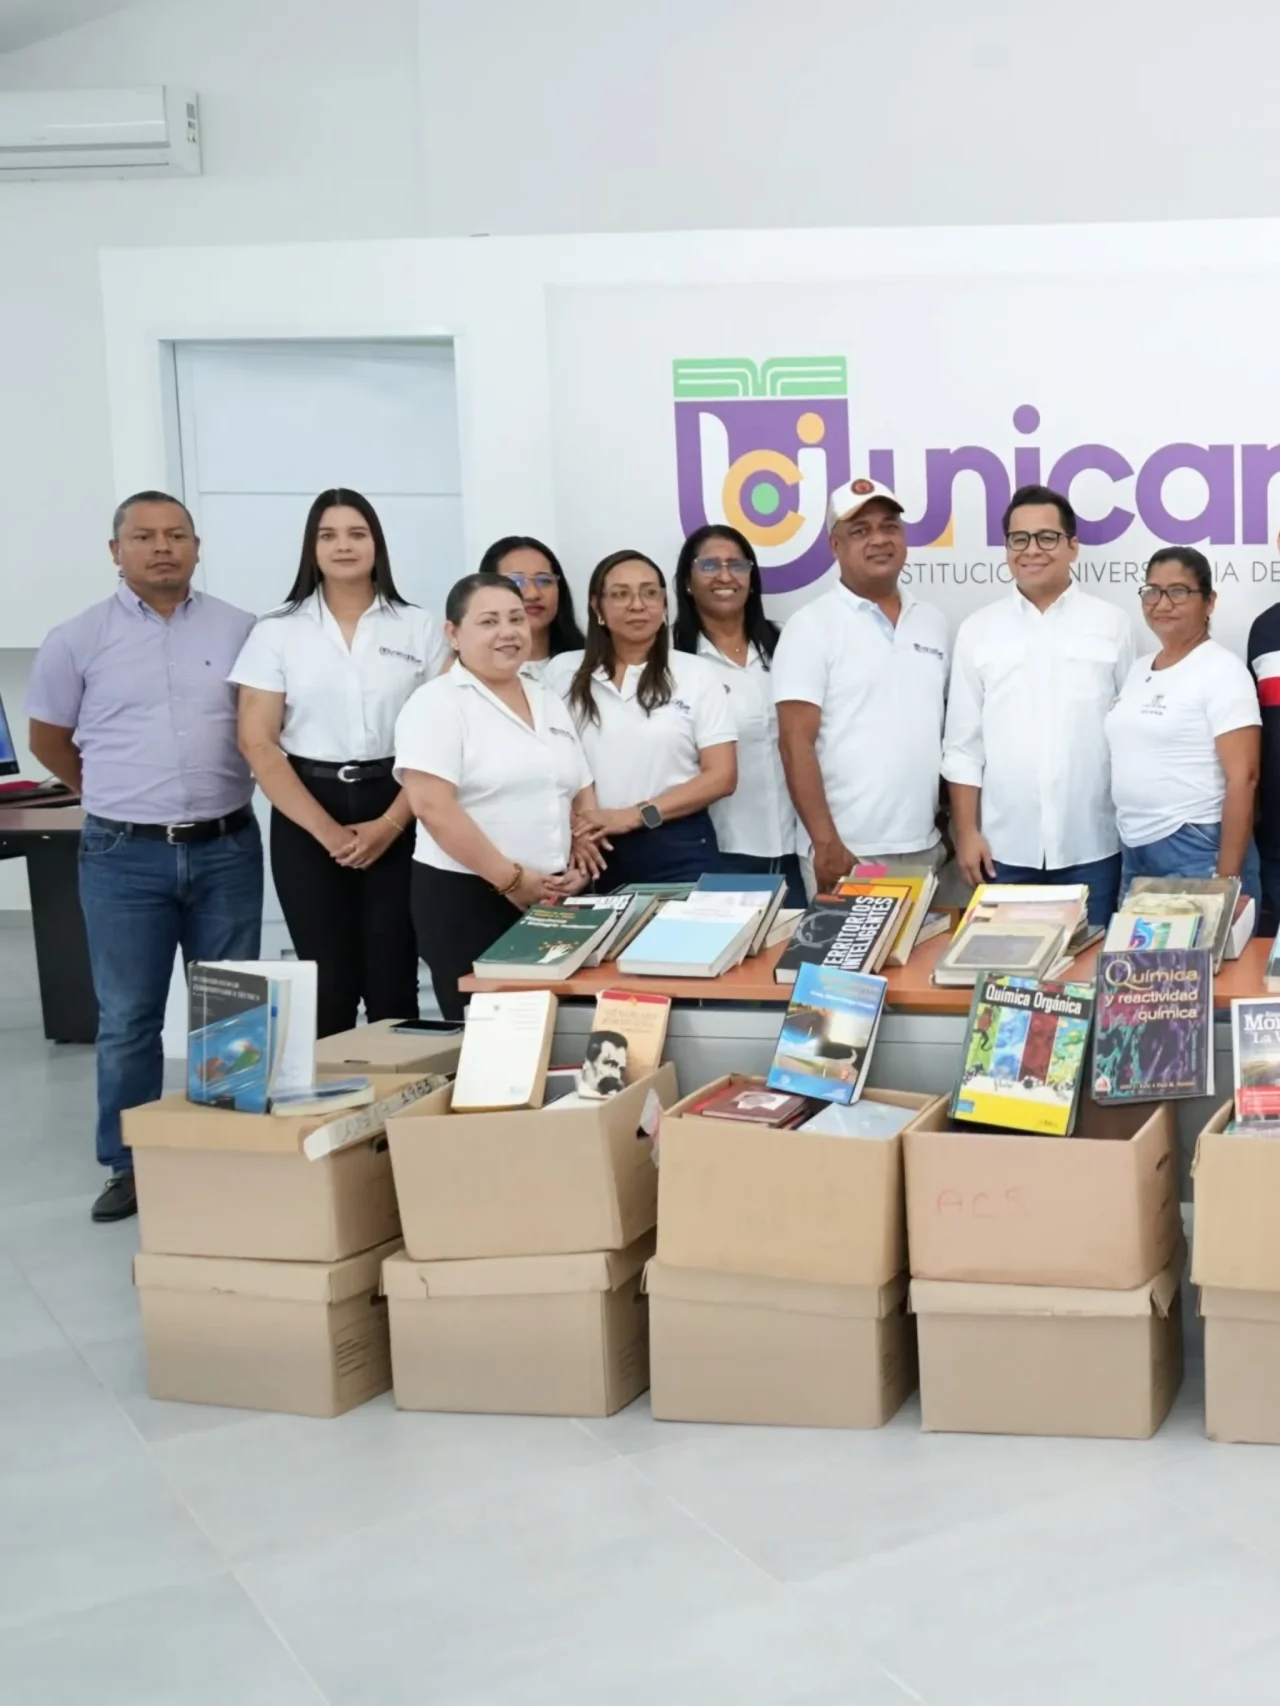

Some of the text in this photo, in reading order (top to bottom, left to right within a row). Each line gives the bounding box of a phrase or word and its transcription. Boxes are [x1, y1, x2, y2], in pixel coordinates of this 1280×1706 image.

[822, 896, 875, 968] ERRITORIOS
[1105, 959, 1198, 991] Química
[985, 983, 1082, 1015] Química Orgánica
[1104, 988, 1198, 1007] y reactividad
[1137, 1006, 1198, 1023] química
